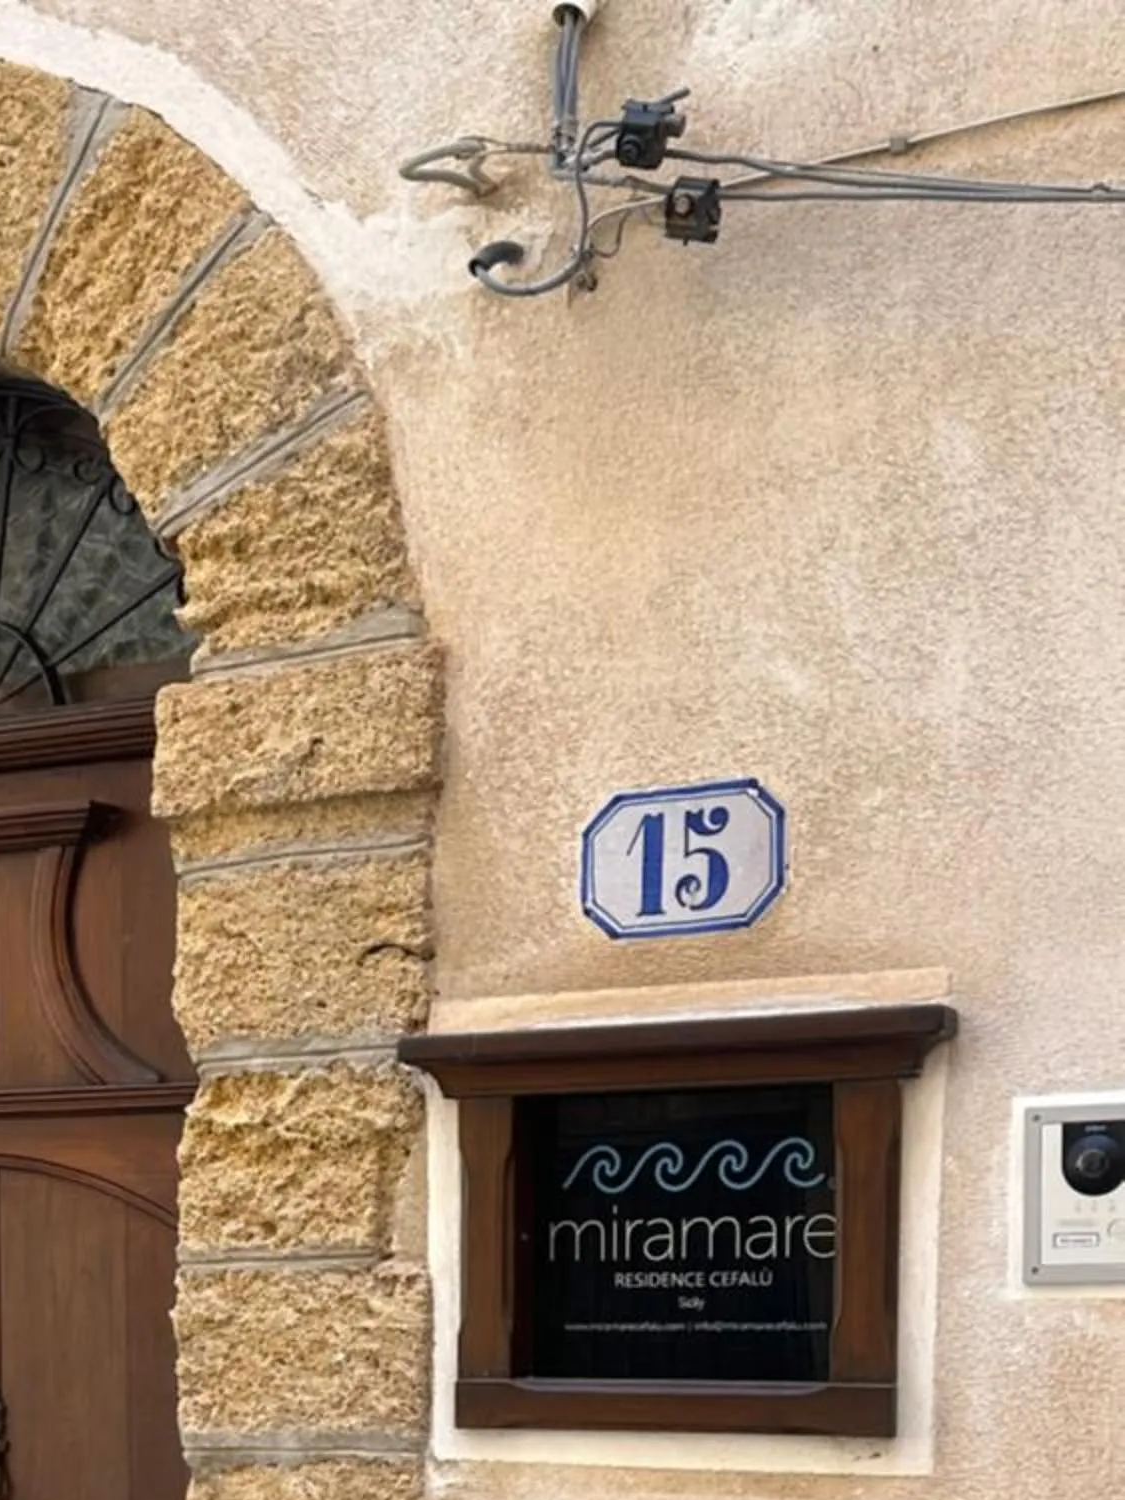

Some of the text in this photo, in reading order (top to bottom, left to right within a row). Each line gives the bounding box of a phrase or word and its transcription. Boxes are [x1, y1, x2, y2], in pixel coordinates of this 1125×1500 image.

[627, 806, 729, 916] 15
[549, 1205, 837, 1262] miramare
[614, 1267, 773, 1288] RESIDENCE CEFALÙ
